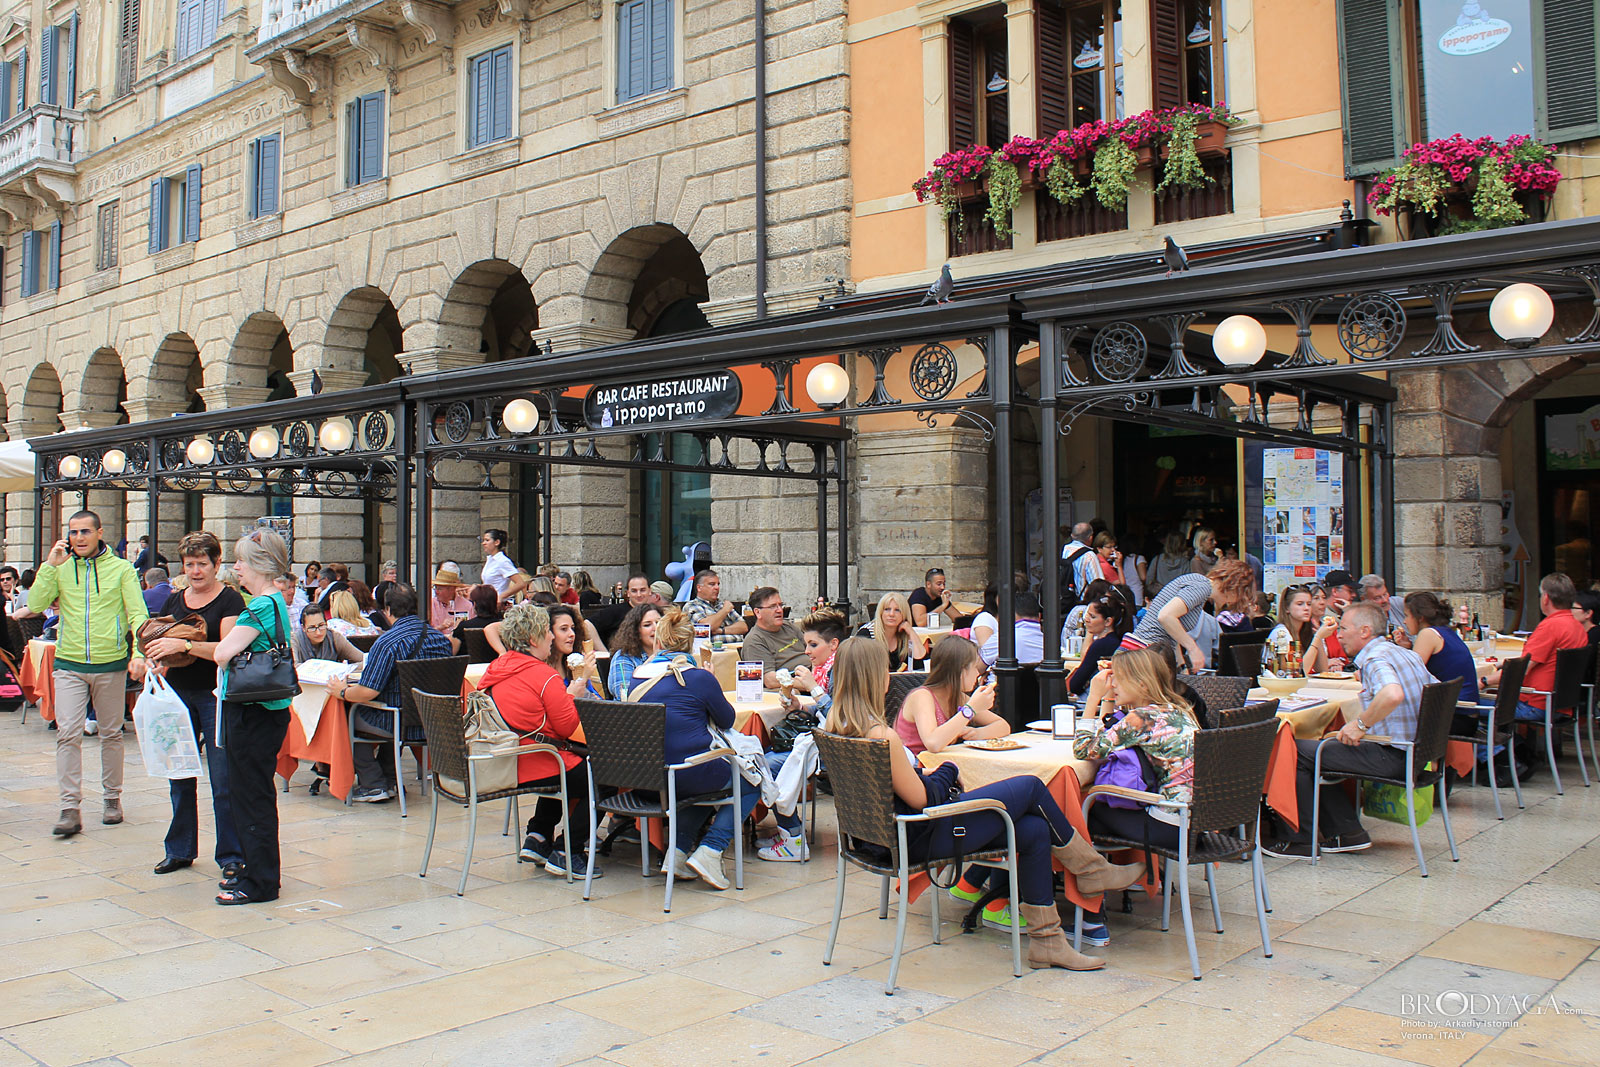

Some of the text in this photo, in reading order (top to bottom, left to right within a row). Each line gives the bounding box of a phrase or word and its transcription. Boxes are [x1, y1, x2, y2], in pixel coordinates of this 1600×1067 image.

[1443, 26, 1509, 48] ippopoTamo
[597, 376, 729, 405] BAR CAFE RESTAURANT
[615, 400, 705, 424] ippopoTamo
